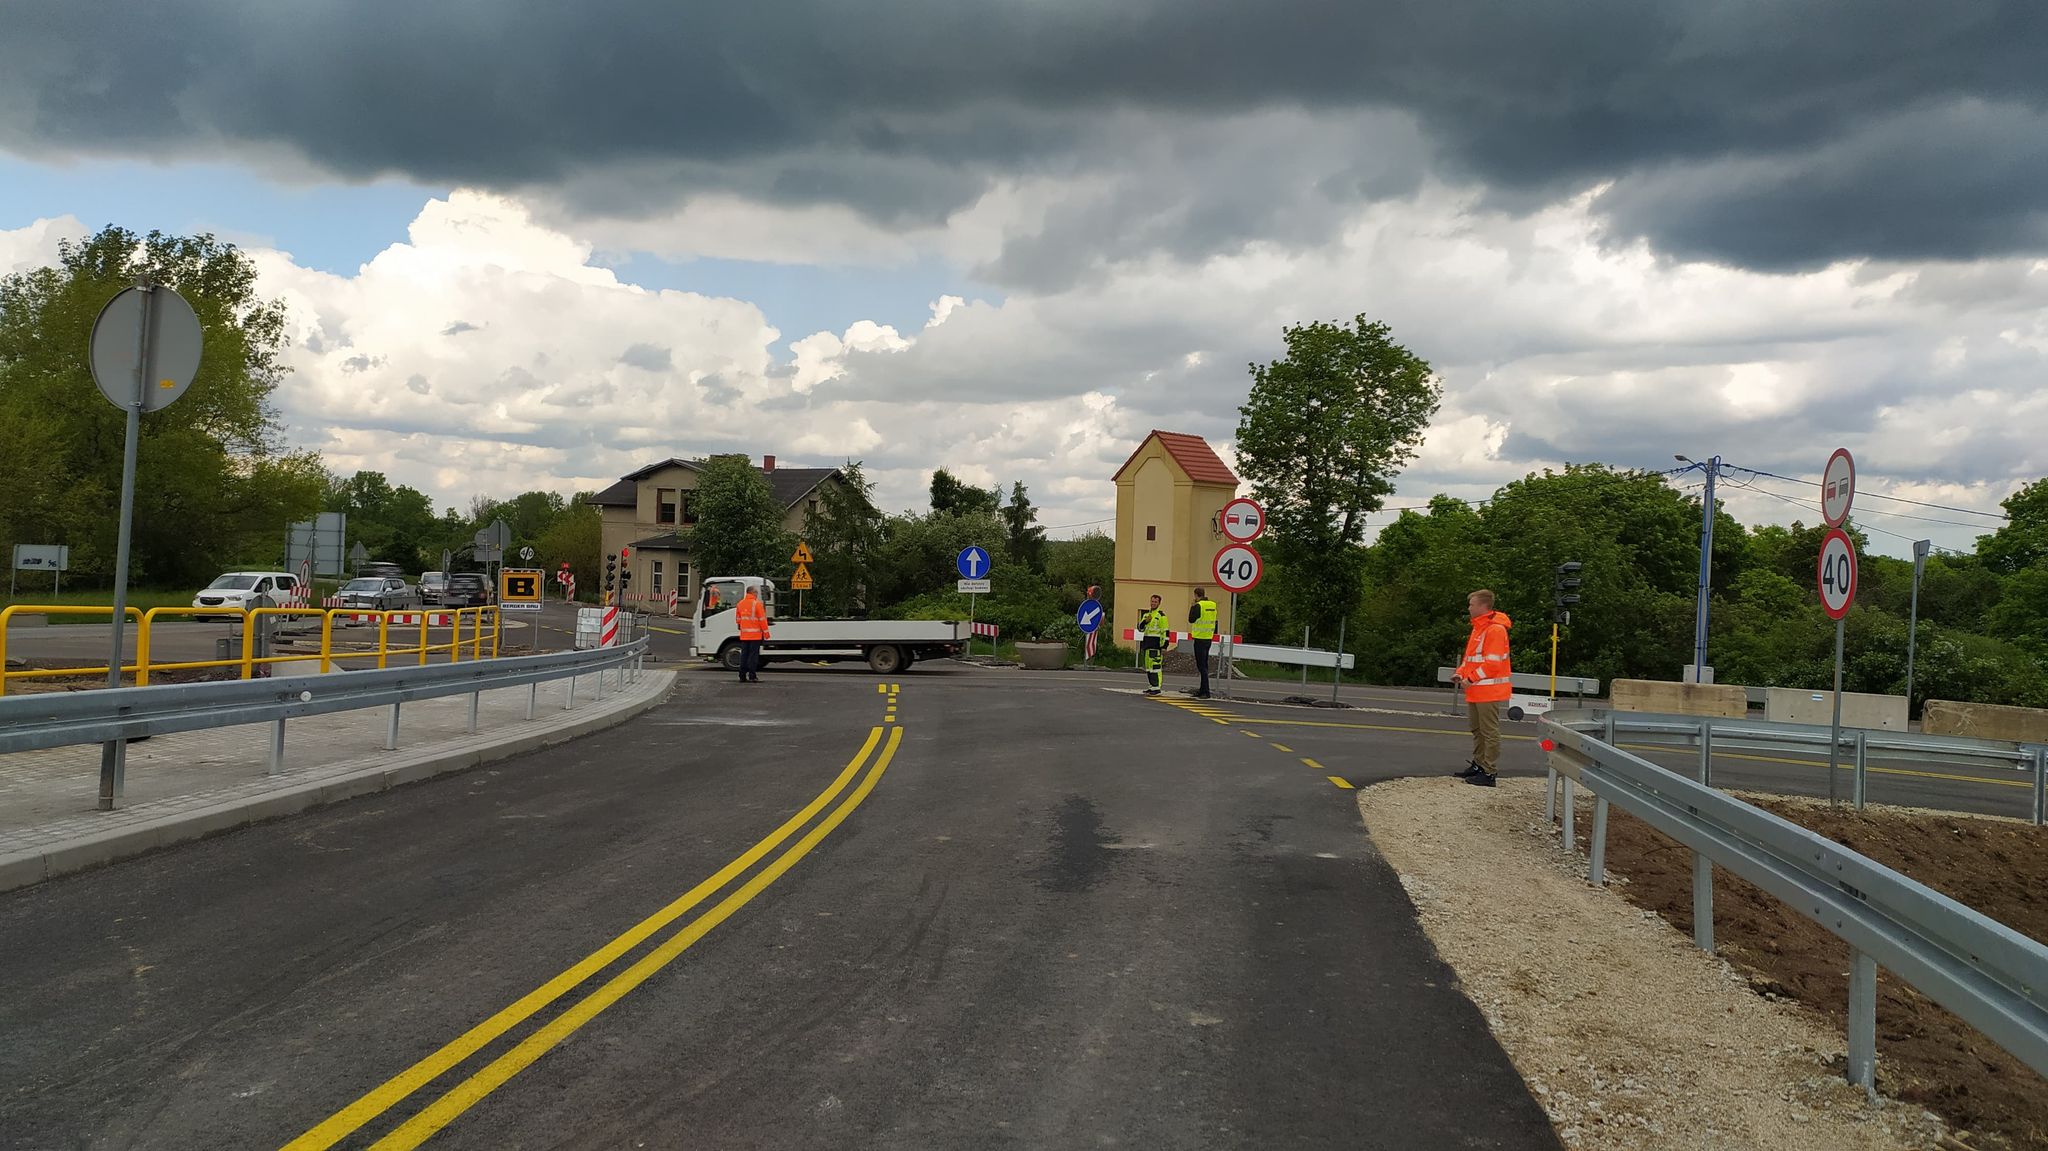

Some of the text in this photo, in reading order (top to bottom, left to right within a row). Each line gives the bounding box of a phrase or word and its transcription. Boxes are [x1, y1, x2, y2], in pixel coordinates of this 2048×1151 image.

[1218, 558, 1252, 580] 40
[1822, 553, 1850, 595] 40
[508, 577, 535, 596] B
